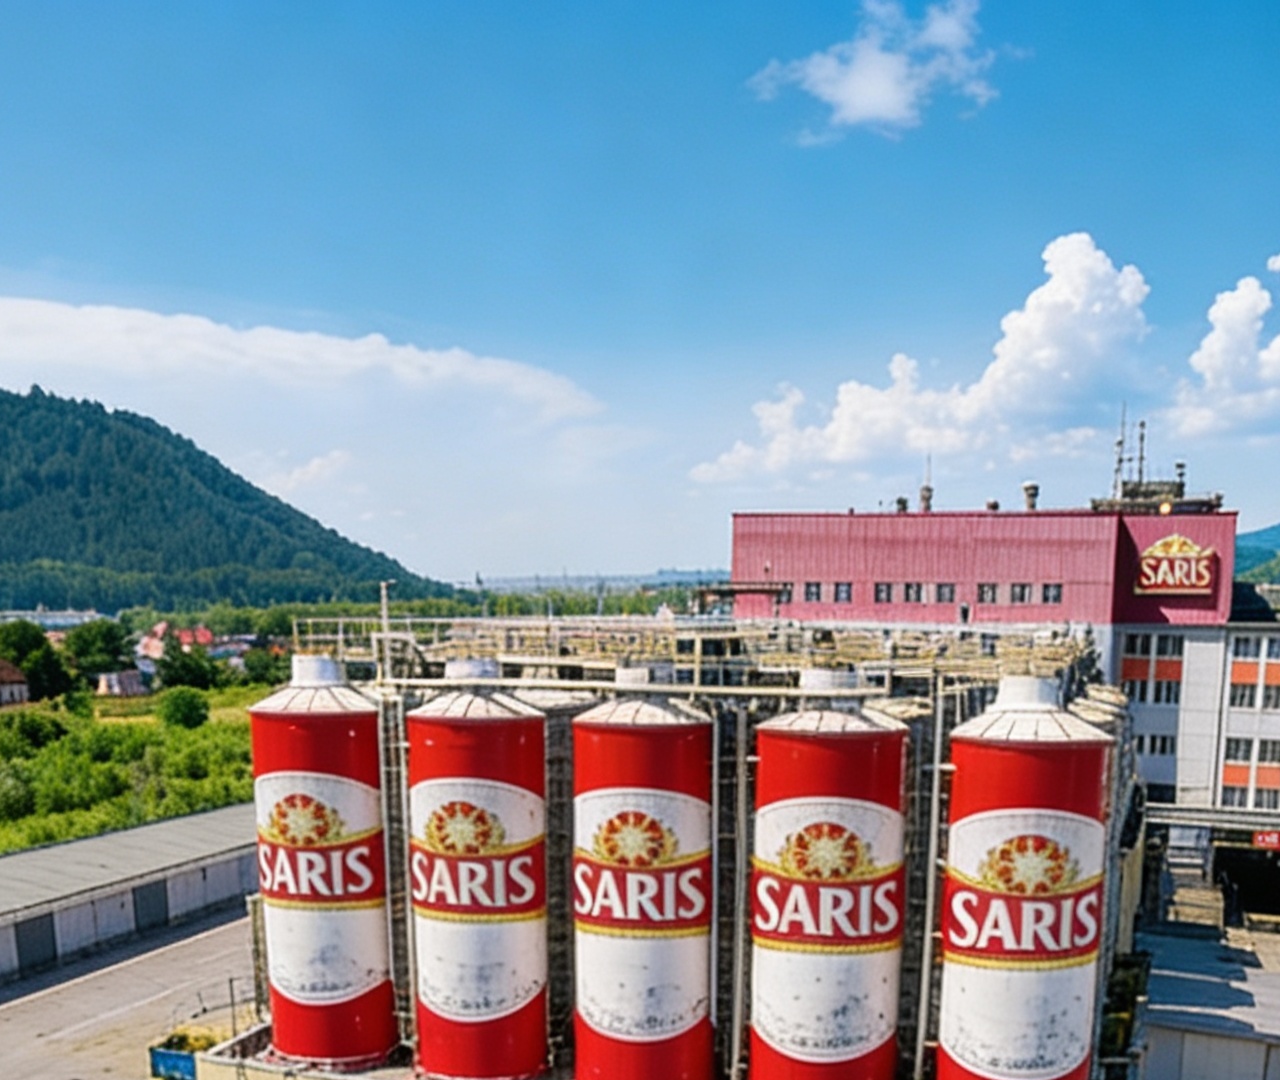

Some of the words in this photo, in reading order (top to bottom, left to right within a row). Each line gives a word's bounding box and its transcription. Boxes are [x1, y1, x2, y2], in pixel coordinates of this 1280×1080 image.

[1140, 558, 1211, 586] SARIS
[258, 846, 374, 895] SARIS
[412, 853, 536, 906] SARIS
[574, 863, 705, 921] SARIS
[755, 878, 900, 937] SARIS
[949, 890, 1097, 950] SARIS
